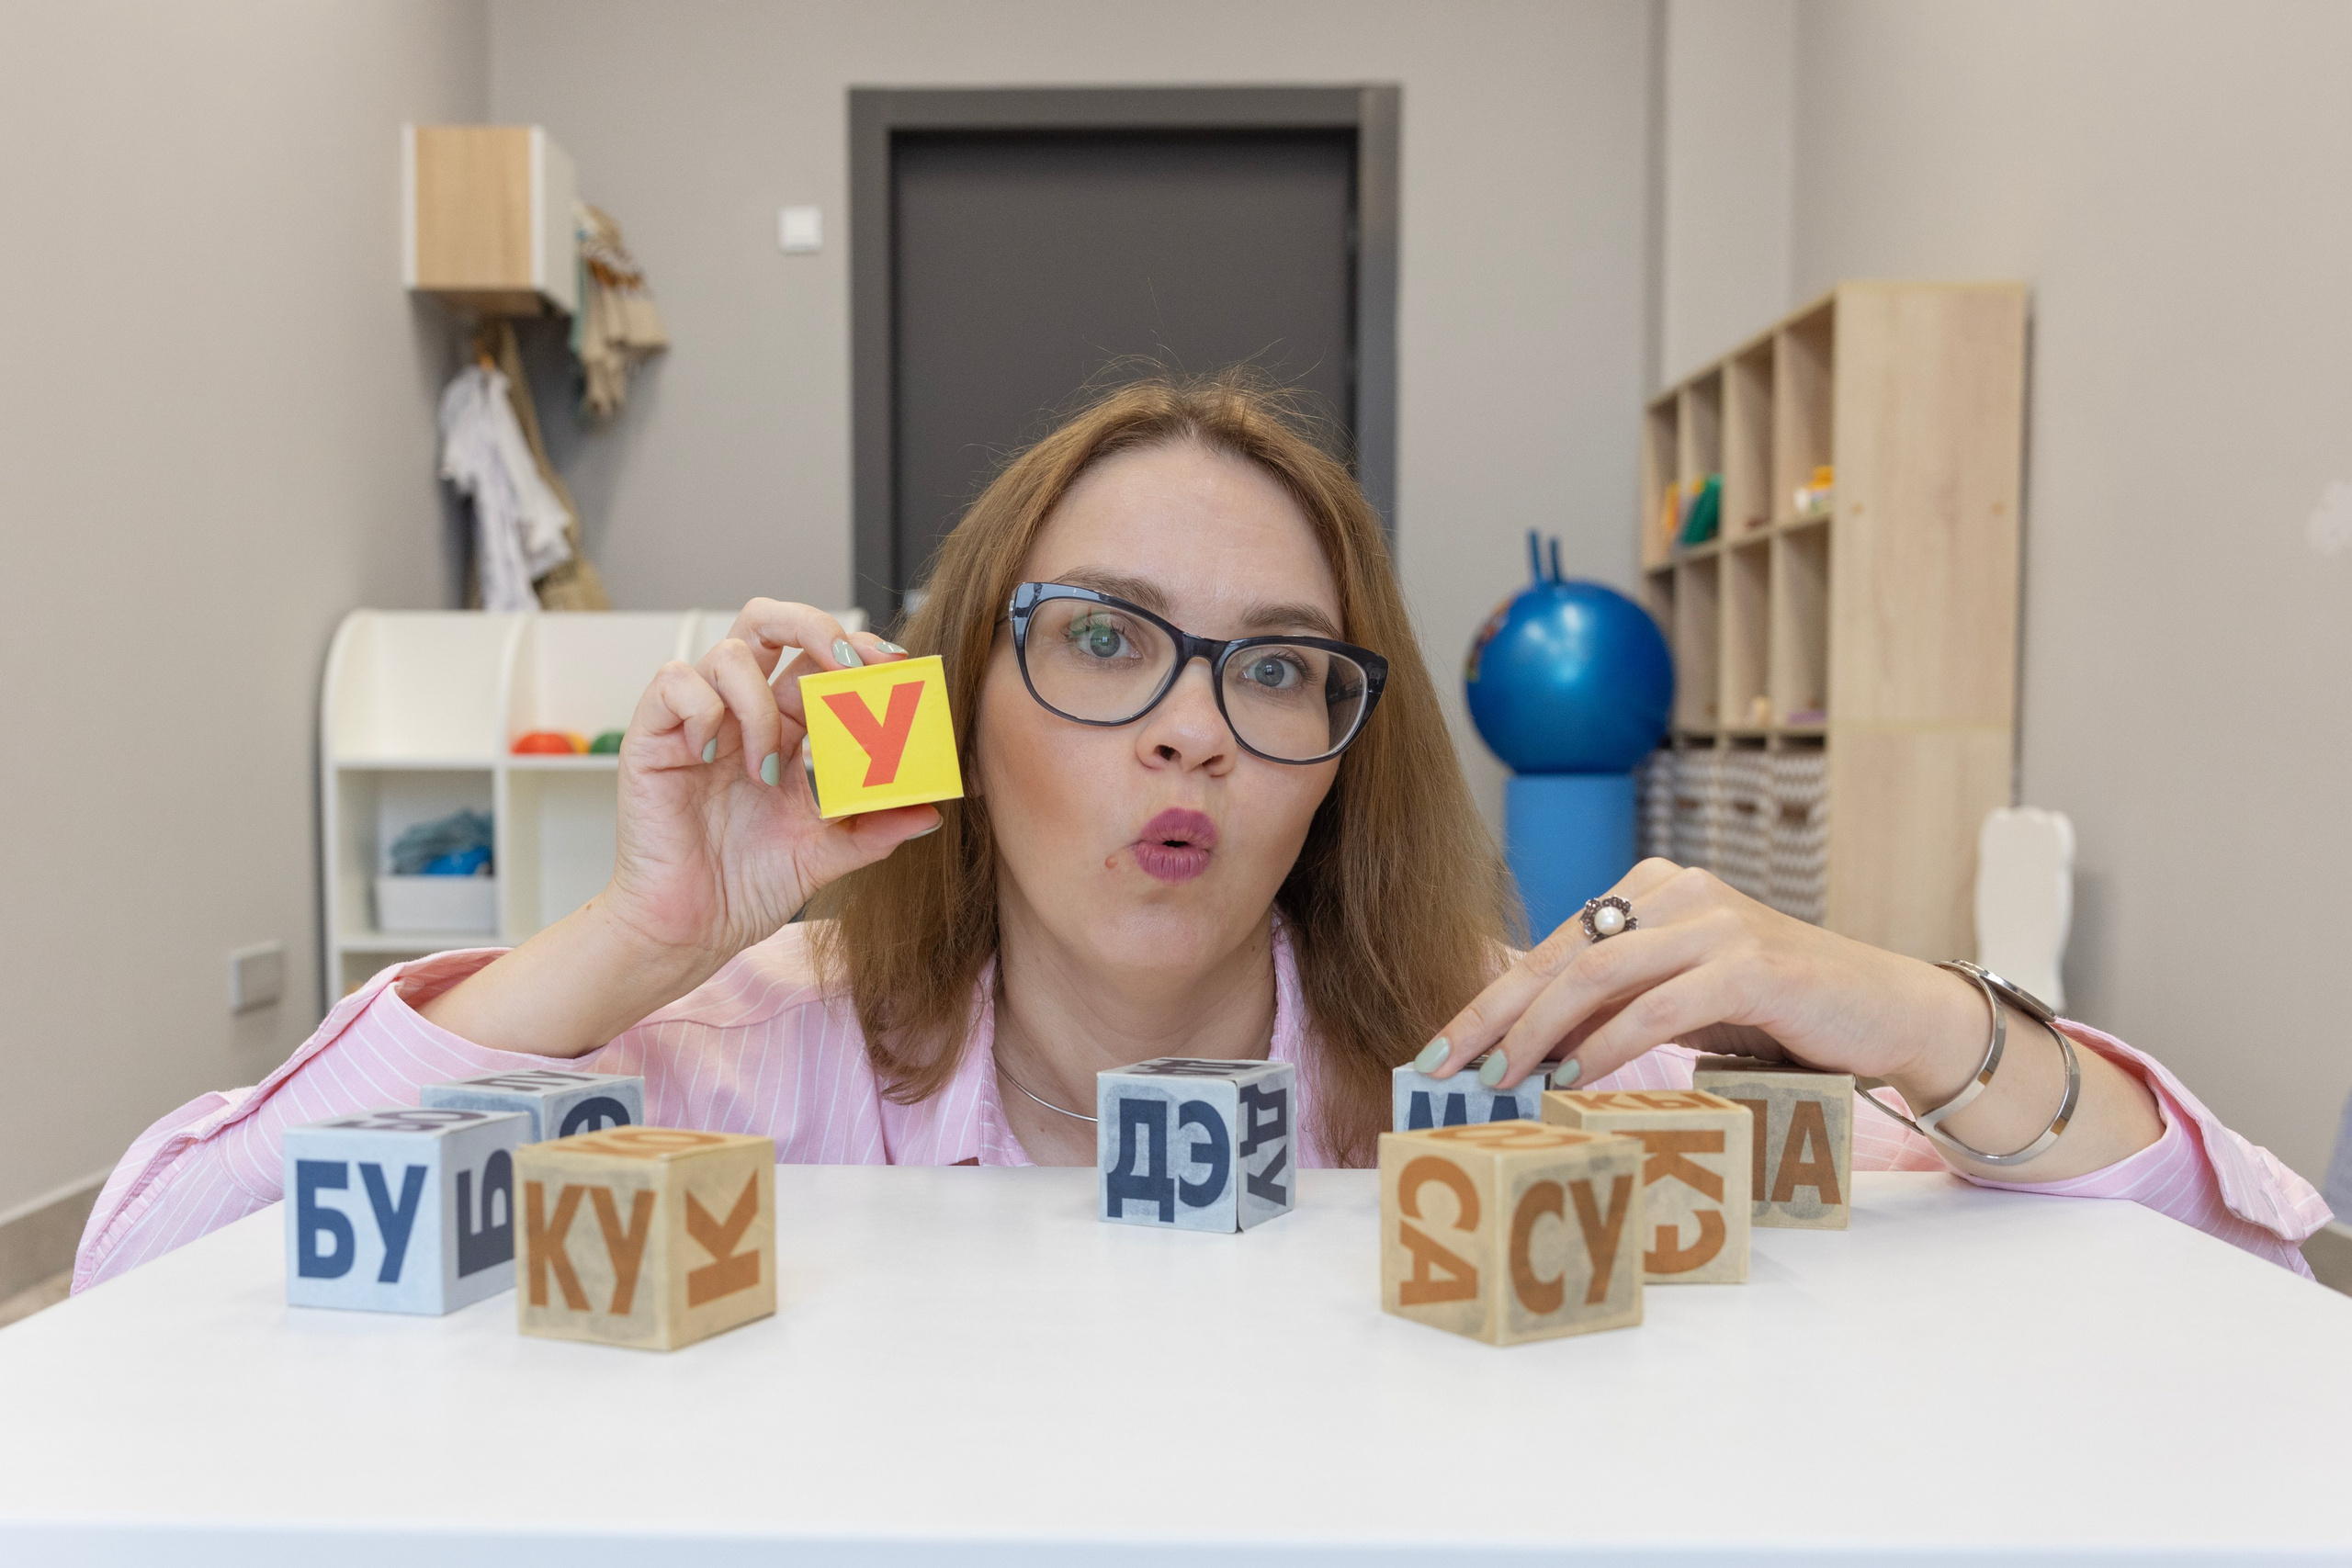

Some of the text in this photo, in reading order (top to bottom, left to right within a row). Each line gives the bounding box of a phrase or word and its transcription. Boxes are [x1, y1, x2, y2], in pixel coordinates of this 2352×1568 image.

[820, 680, 926, 788] У
[295, 1158, 430, 1284] БУ
[1106, 1097, 1231, 1224] ДЭ
[524, 1179, 658, 1316] КУ
[684, 1167, 761, 1310] К
[1396, 1155, 1481, 1307] СА
[1509, 1173, 1635, 1315] СУ
